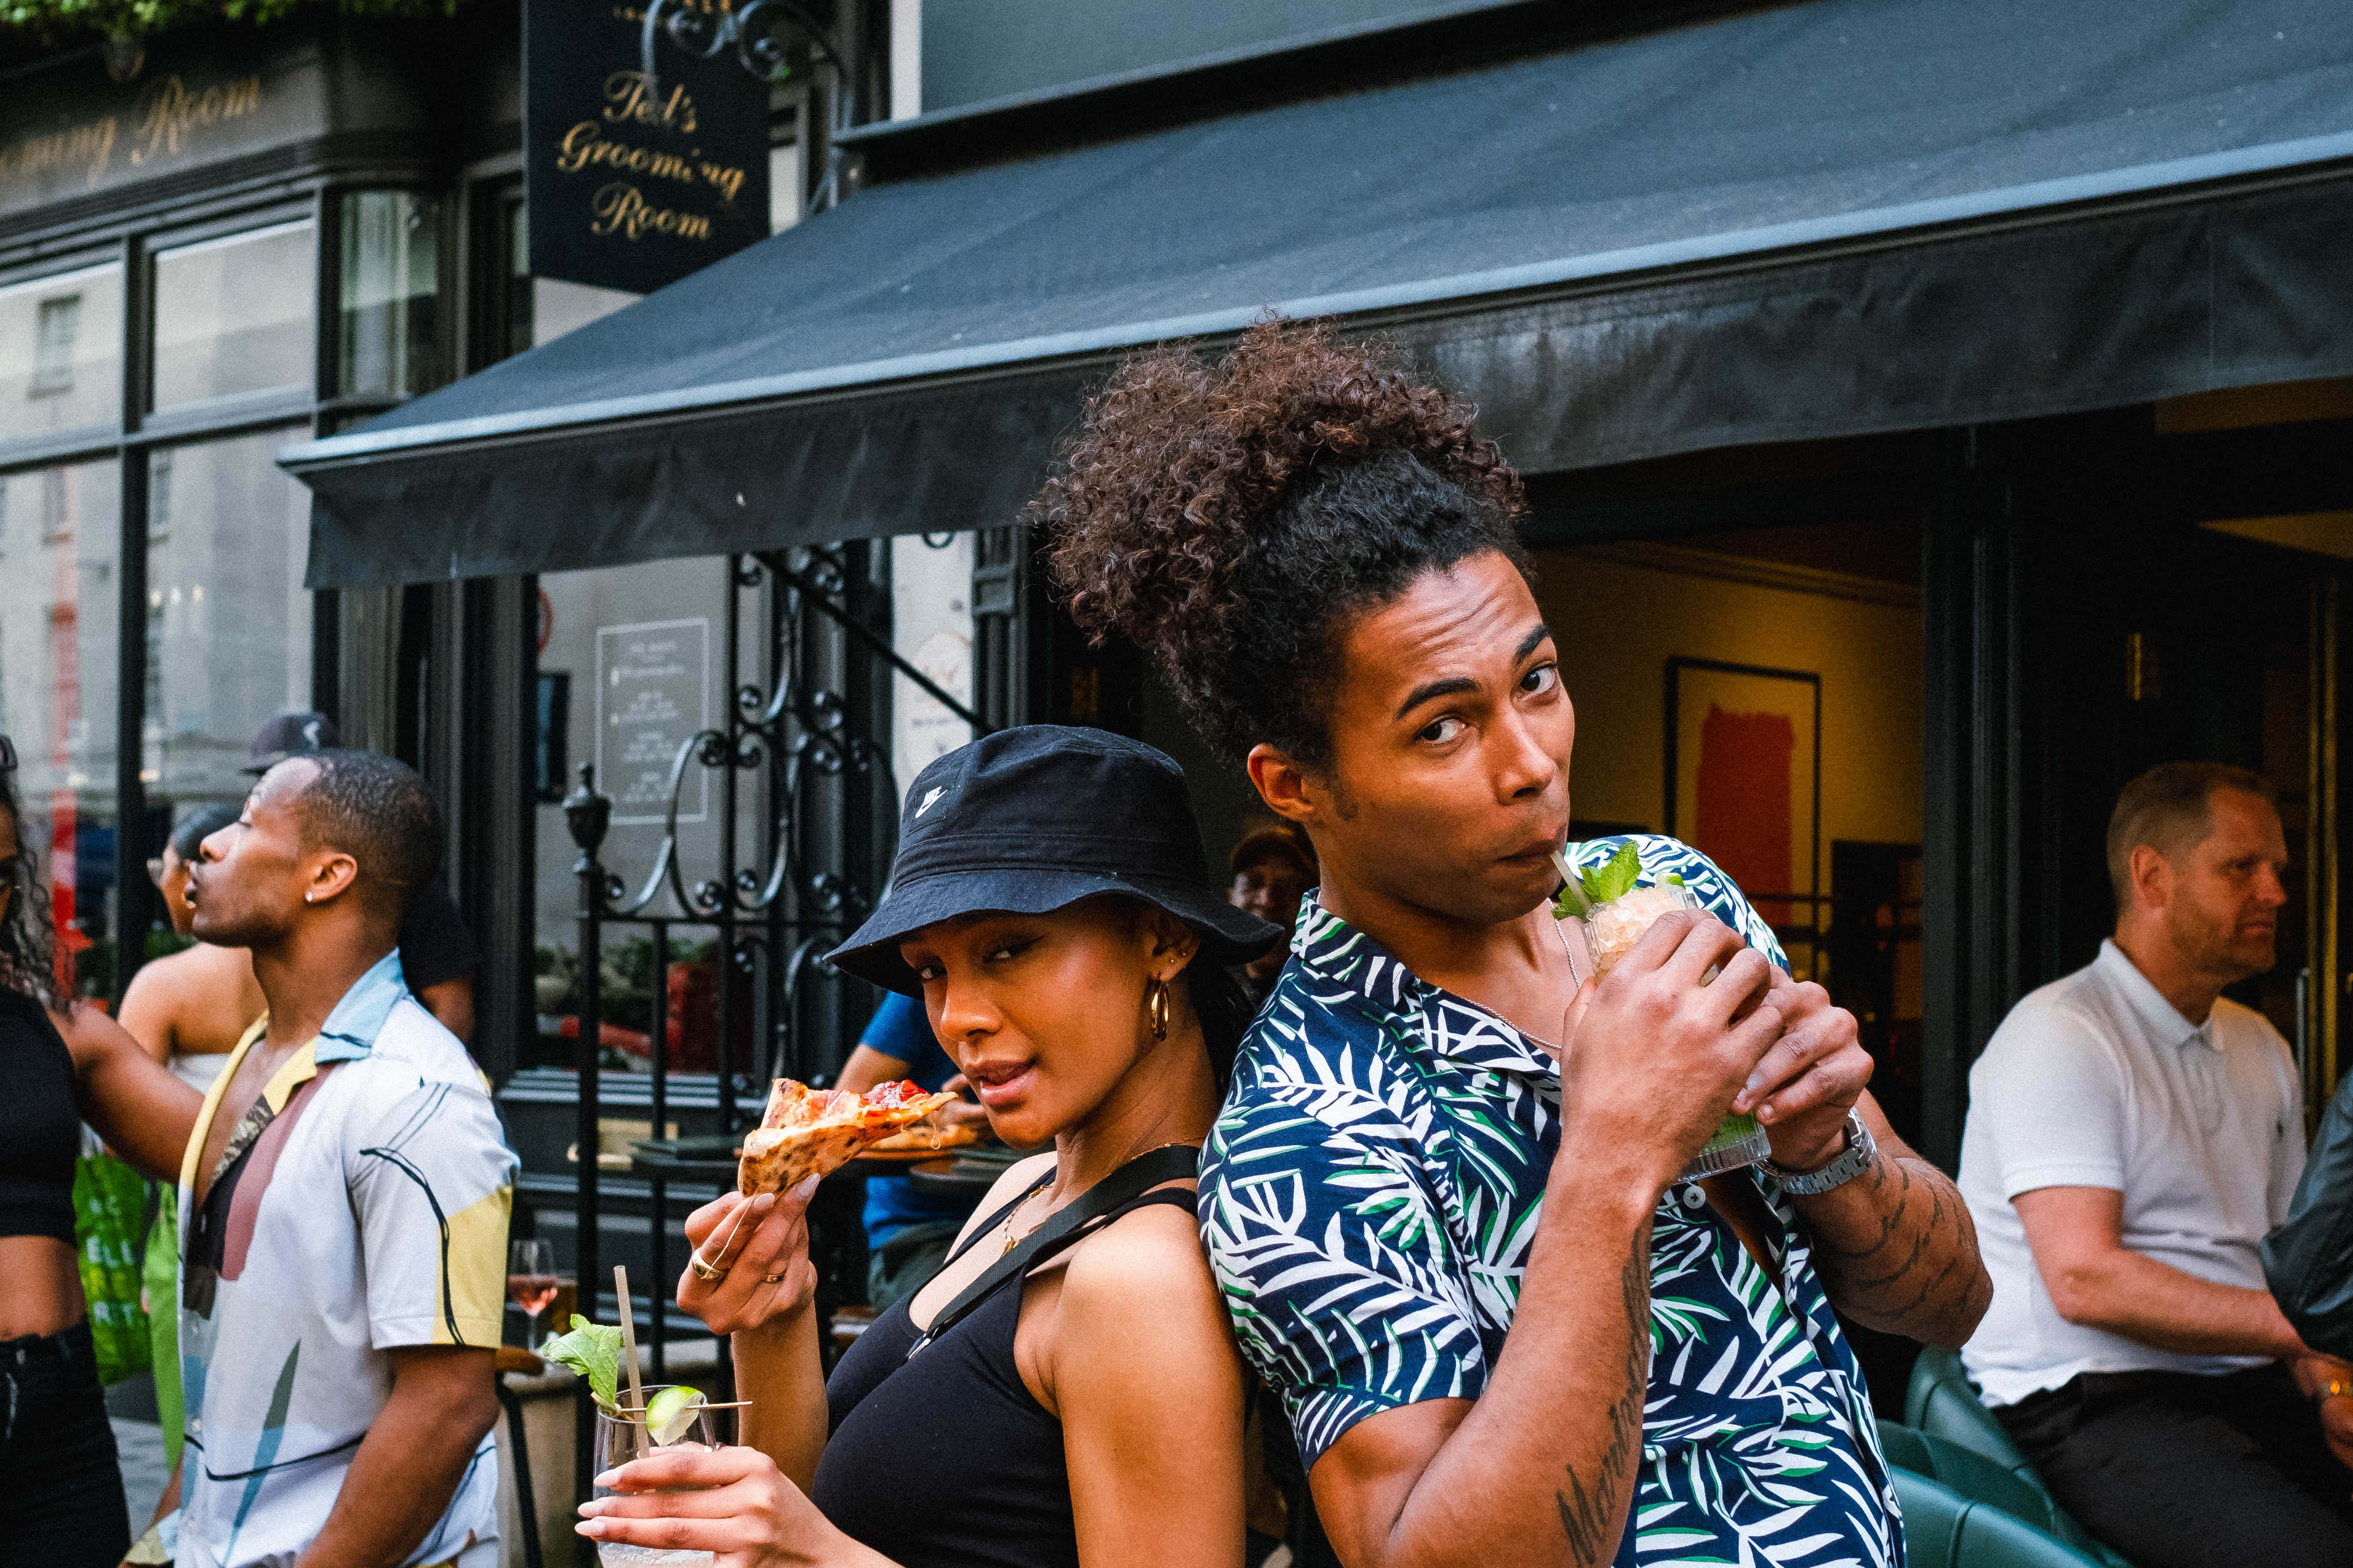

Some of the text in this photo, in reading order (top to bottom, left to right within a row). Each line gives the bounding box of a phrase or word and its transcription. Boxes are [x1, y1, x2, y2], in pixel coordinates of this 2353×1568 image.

[130, 74, 261, 167] Room
[557, 121, 745, 202] Grooming
[591, 182, 711, 241] Room
